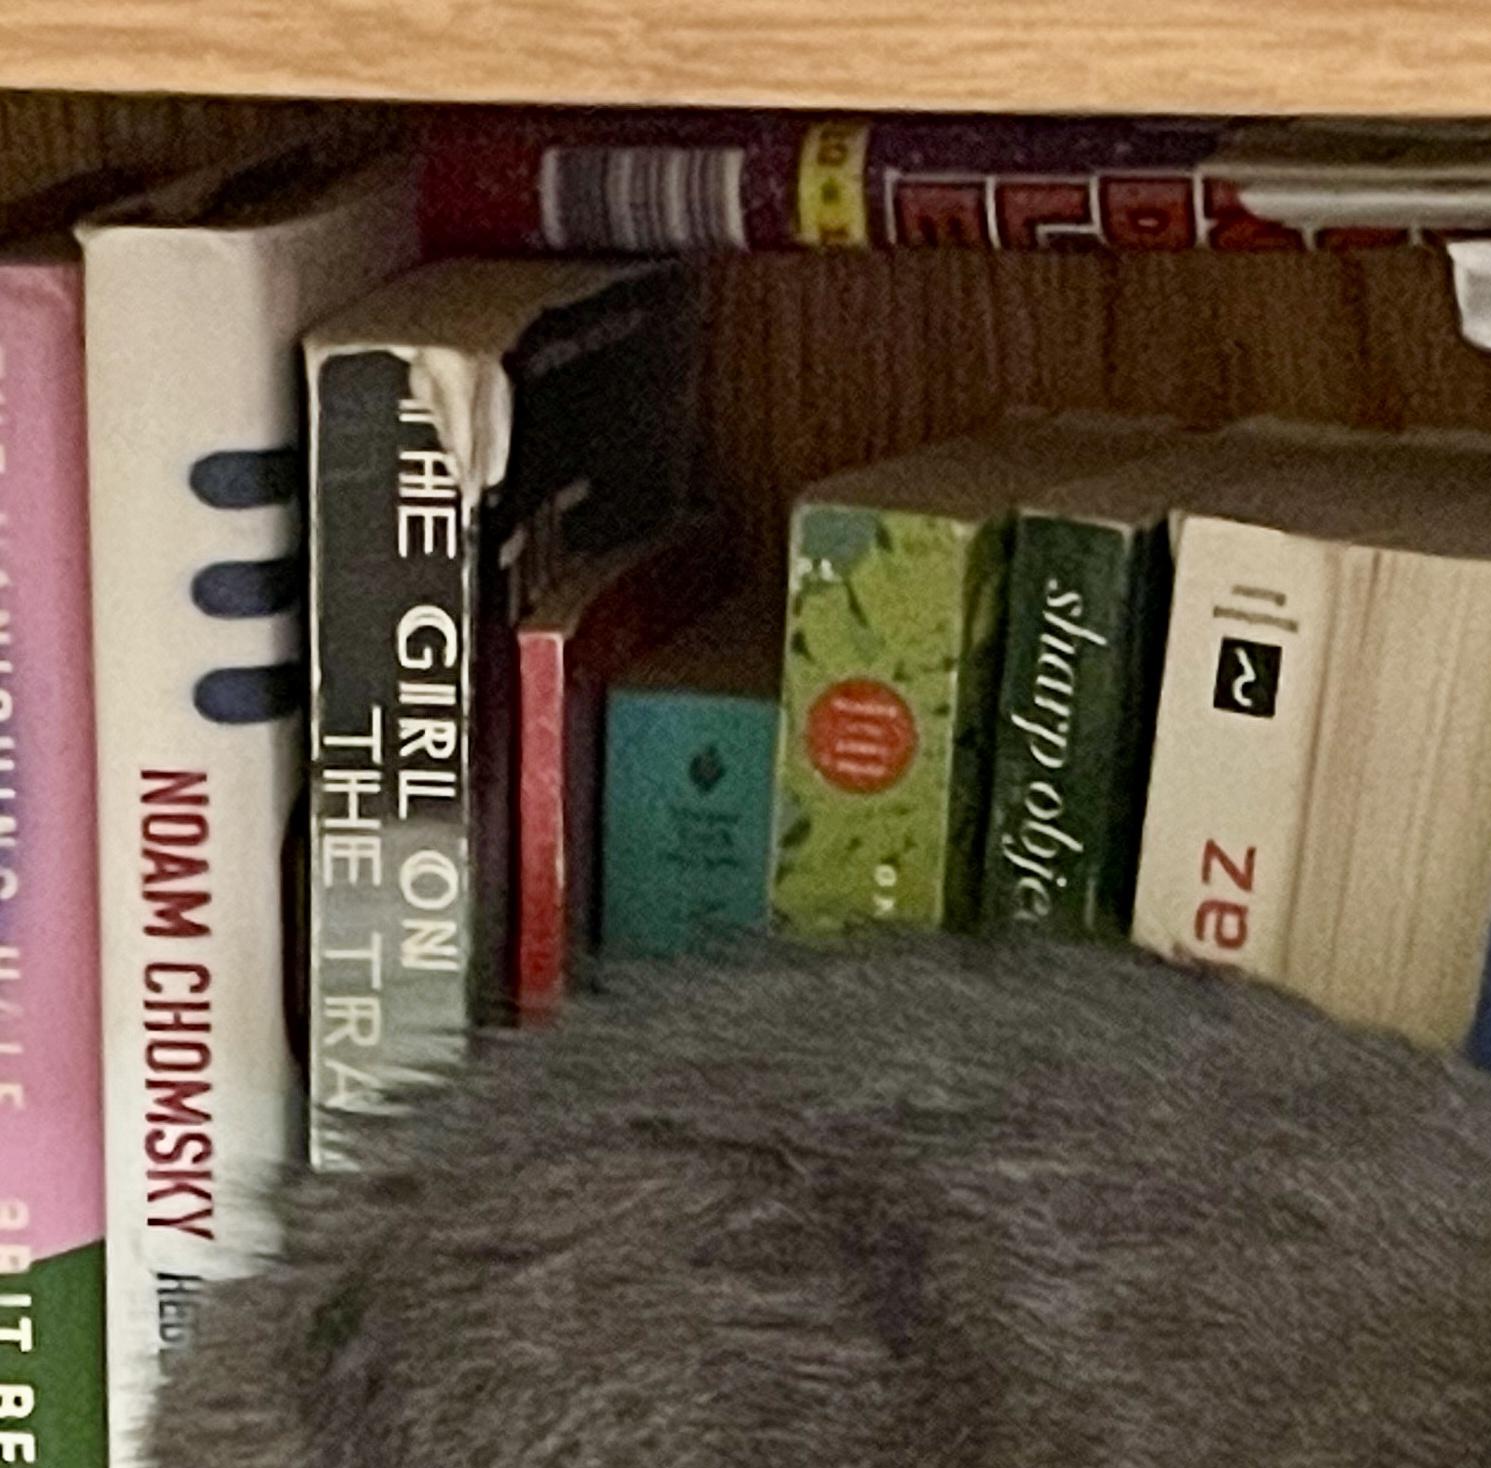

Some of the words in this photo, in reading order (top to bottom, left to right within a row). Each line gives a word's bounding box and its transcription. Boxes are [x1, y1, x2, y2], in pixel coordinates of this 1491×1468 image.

[398, 604, 458, 820] GIRL
[1010, 578, 1108, 768] sharp
[140, 769, 212, 939] NOAM
[323, 705, 382, 887] THE
[400, 850, 461, 972] ON
[1192, 838, 1257, 951] az
[143, 962, 215, 1241] CHOMSKY
